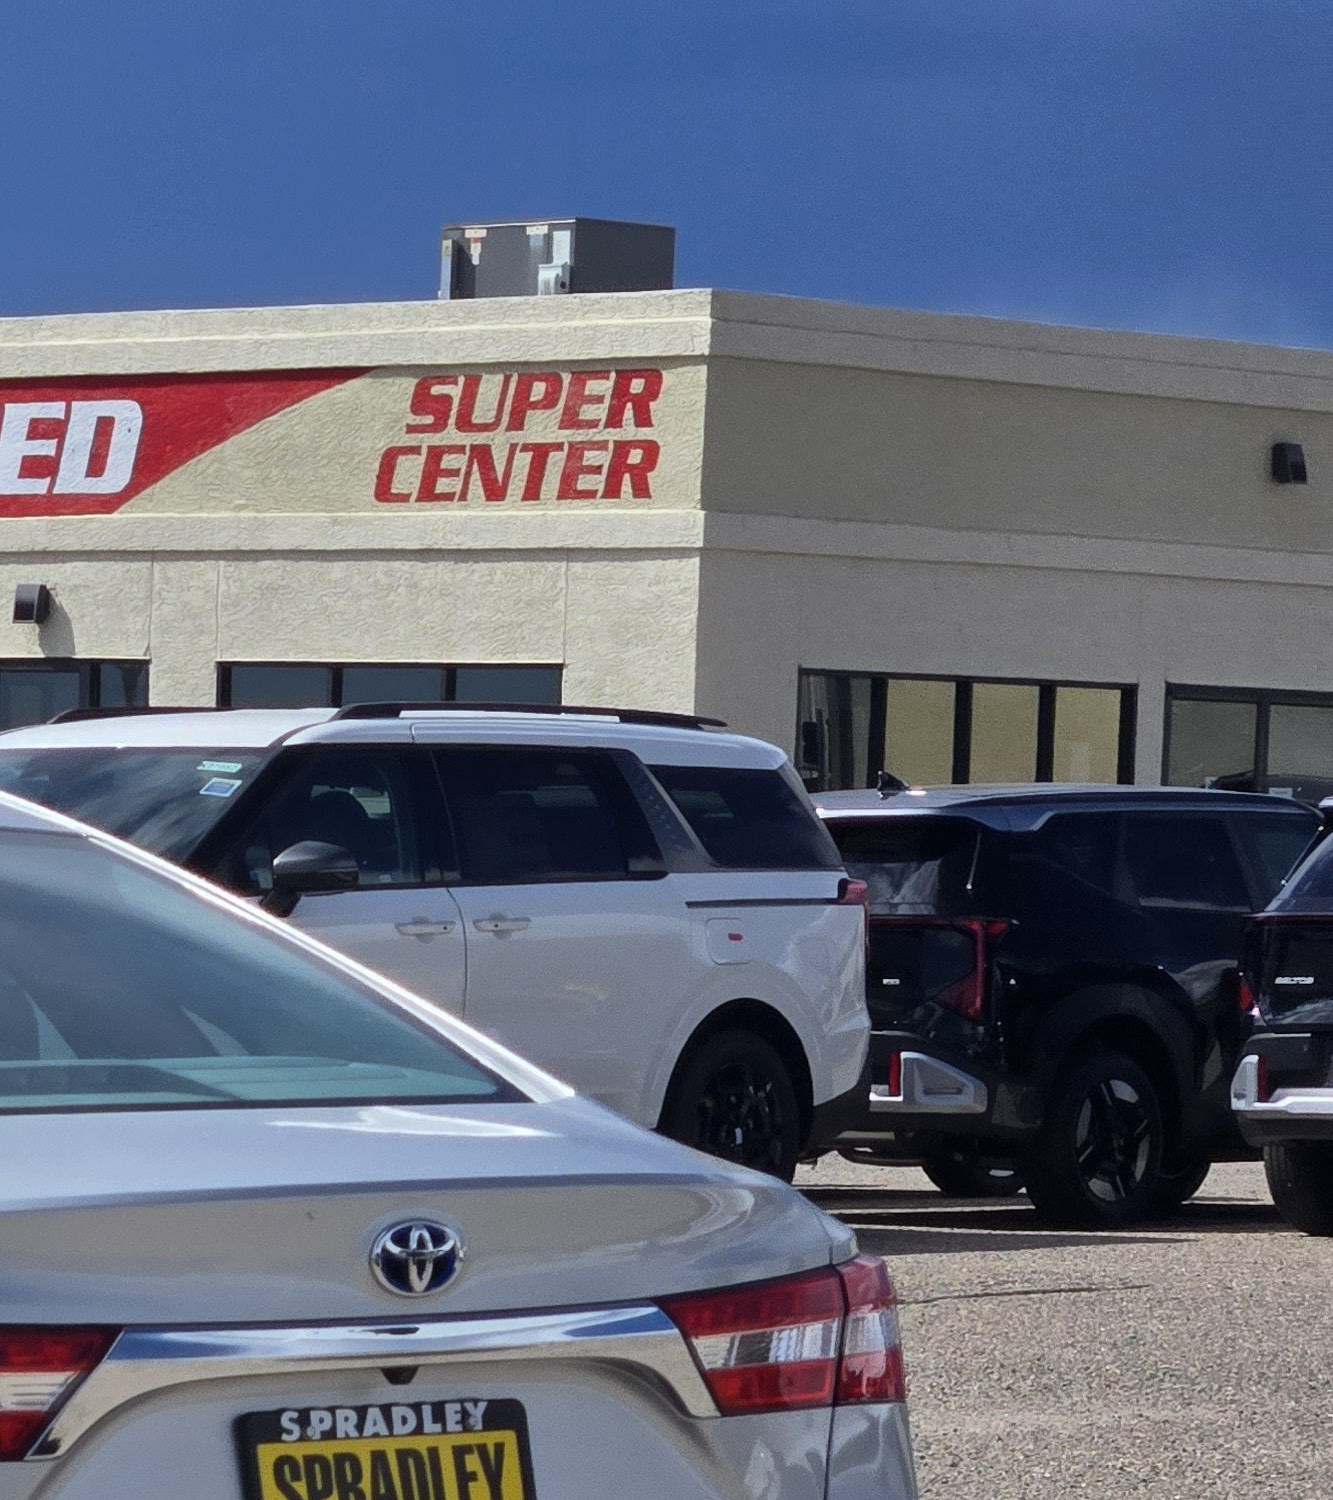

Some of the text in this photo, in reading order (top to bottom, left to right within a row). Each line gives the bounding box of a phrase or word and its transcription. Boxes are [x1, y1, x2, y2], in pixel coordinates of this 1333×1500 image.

[405, 368, 664, 434] SUPER
[374, 439, 661, 503] CENTER
[280, 1401, 488, 1442] SPRADLEY
